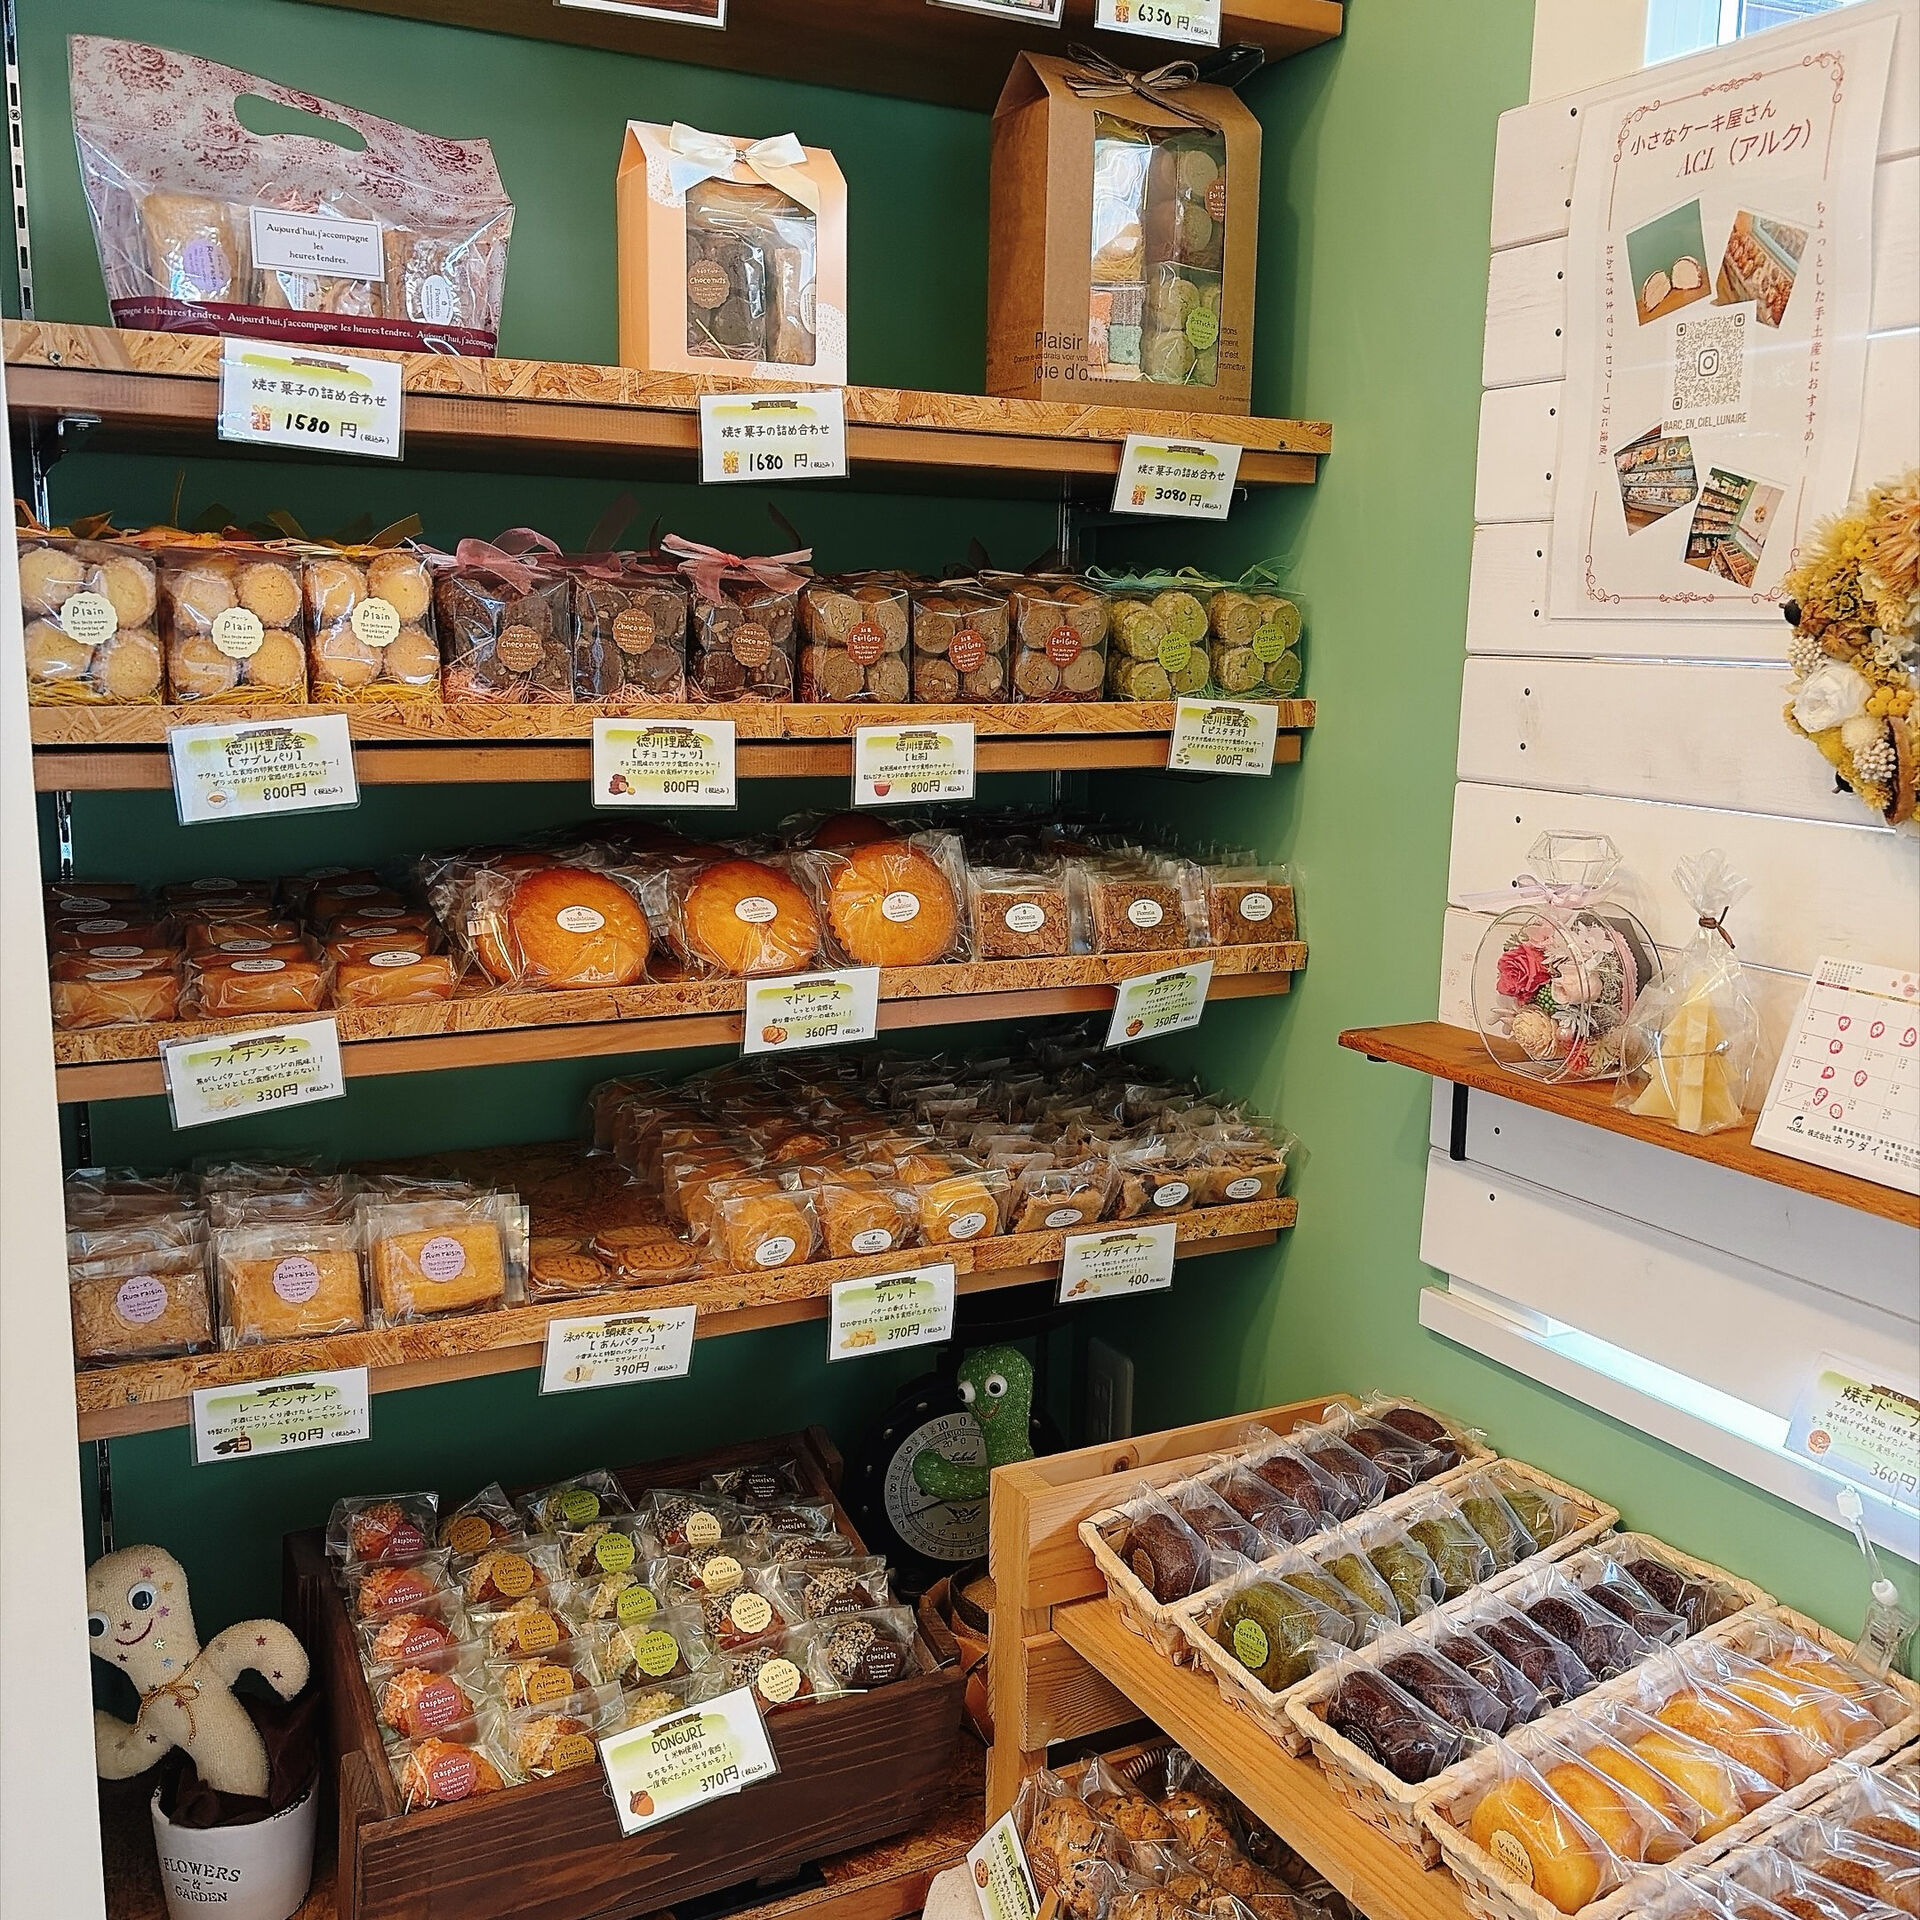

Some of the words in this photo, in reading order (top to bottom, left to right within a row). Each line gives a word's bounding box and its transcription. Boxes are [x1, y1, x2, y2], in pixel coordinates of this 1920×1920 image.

[1138, 3, 1171, 26] 6350
[1177, 15, 1190, 31] 円
[1631, 99, 1777, 156] 小さなケーキ屋さん
[313, 242, 324, 251] les
[289, 250, 315, 261] heures
[316, 252, 349, 265] tendres.
[157, 306, 187, 317] heures
[187, 307, 224, 321] tendres.
[340, 323, 352, 332] les
[353, 324, 380, 335] heures
[380, 325, 413, 338] tendres.
[1033, 331, 1083, 350] Plaisir
[1033, 363, 1059, 381] joie
[252, 377, 388, 407] 焼き菓子の詰め合わせ
[286, 413, 330, 434] 1580
[340, 421, 358, 439] 円
[721, 424, 830, 438] 焼き菓子の詰め合わせ
[749, 453, 783, 472] 1680
[794, 453, 808, 468] 円
[1137, 464, 1226, 481] 焼き菓子の詰め合わせ
[1154, 487, 1187, 502] 3080
[1189, 493, 1202, 507] 円
[72, 605, 104, 617] Plain
[362, 609, 391, 621] Plain
[223, 620, 253, 632] Plain
[616, 623, 638, 633] Choco
[501, 640, 524, 650] Choco
[735, 636, 757, 645] Choco
[1202, 713, 1252, 729] 徳川埋蔵金
[225, 735, 307, 756] 徳川埋蔵金
[636, 735, 704, 749] 徳川埋蔵金
[895, 739, 941, 752] 徳川埋蔵金
[1215, 754, 1243, 767] 800円
[263, 782, 307, 801] 800円
[663, 780, 700, 794] 800円
[910, 779, 941, 794] 800円
[1147, 980, 1192, 997] フロランタン
[783, 990, 841, 1006] マドレーヌ
[1153, 1012, 1181, 1029] 350円
[805, 1023, 838, 1039] 360円
[210, 1044, 300, 1067] フィナンシェ
[256, 1083, 299, 1103] 330円
[425, 1250, 442, 1260] Rum
[441, 1249, 462, 1258] raisin
[1080, 1243, 1155, 1261] エンガディナー
[278, 1272, 295, 1281] Rum
[295, 1270, 316, 1279] raisin
[1128, 1273, 1149, 1287] 400
[122, 1292, 140, 1303] Rum
[140, 1288, 163, 1298] raisin
[877, 1288, 917, 1303] ガレット
[888, 1323, 920, 1341] 370円
[613, 1361, 650, 1377] 390円
[239, 1390, 338, 1413] レーズンサンド
[936, 1420, 949, 1432] 10
[959, 1416, 967, 1427] 0
[280, 1427, 325, 1446] 390円
[904, 1446, 913, 1455] 9
[1869, 1461, 1917, 1493] 360円
[889, 1483, 897, 1492] 8
[909, 1485, 918, 1493] 16
[910, 1499, 920, 1507] 15
[690, 1522, 717, 1532] Vanilla
[392, 1536, 421, 1545] Raspberry
[498, 1566, 527, 1576] Almond
[708, 1565, 737, 1577] Vanilla
[388, 1592, 423, 1605] Raspberry
[735, 1600, 764, 1616] Vanilla
[523, 1624, 552, 1636] Almond
[405, 1637, 440, 1655] Raspberry
[639, 1641, 675, 1655] Pistachio
[866, 1651, 898, 1663] Chocolate
[764, 1668, 793, 1683] Vanilla
[535, 1678, 566, 1690] Almond
[419, 1694, 456, 1711] Raspberry
[651, 1723, 706, 1755] DONGURI
[559, 1746, 589, 1762] Almond
[432, 1762, 471, 1781] Raspberry
[699, 1764, 739, 1793] 370円
[162, 1857, 242, 1883] FLOWERS
[175, 1885, 228, 1903] GARDEN
